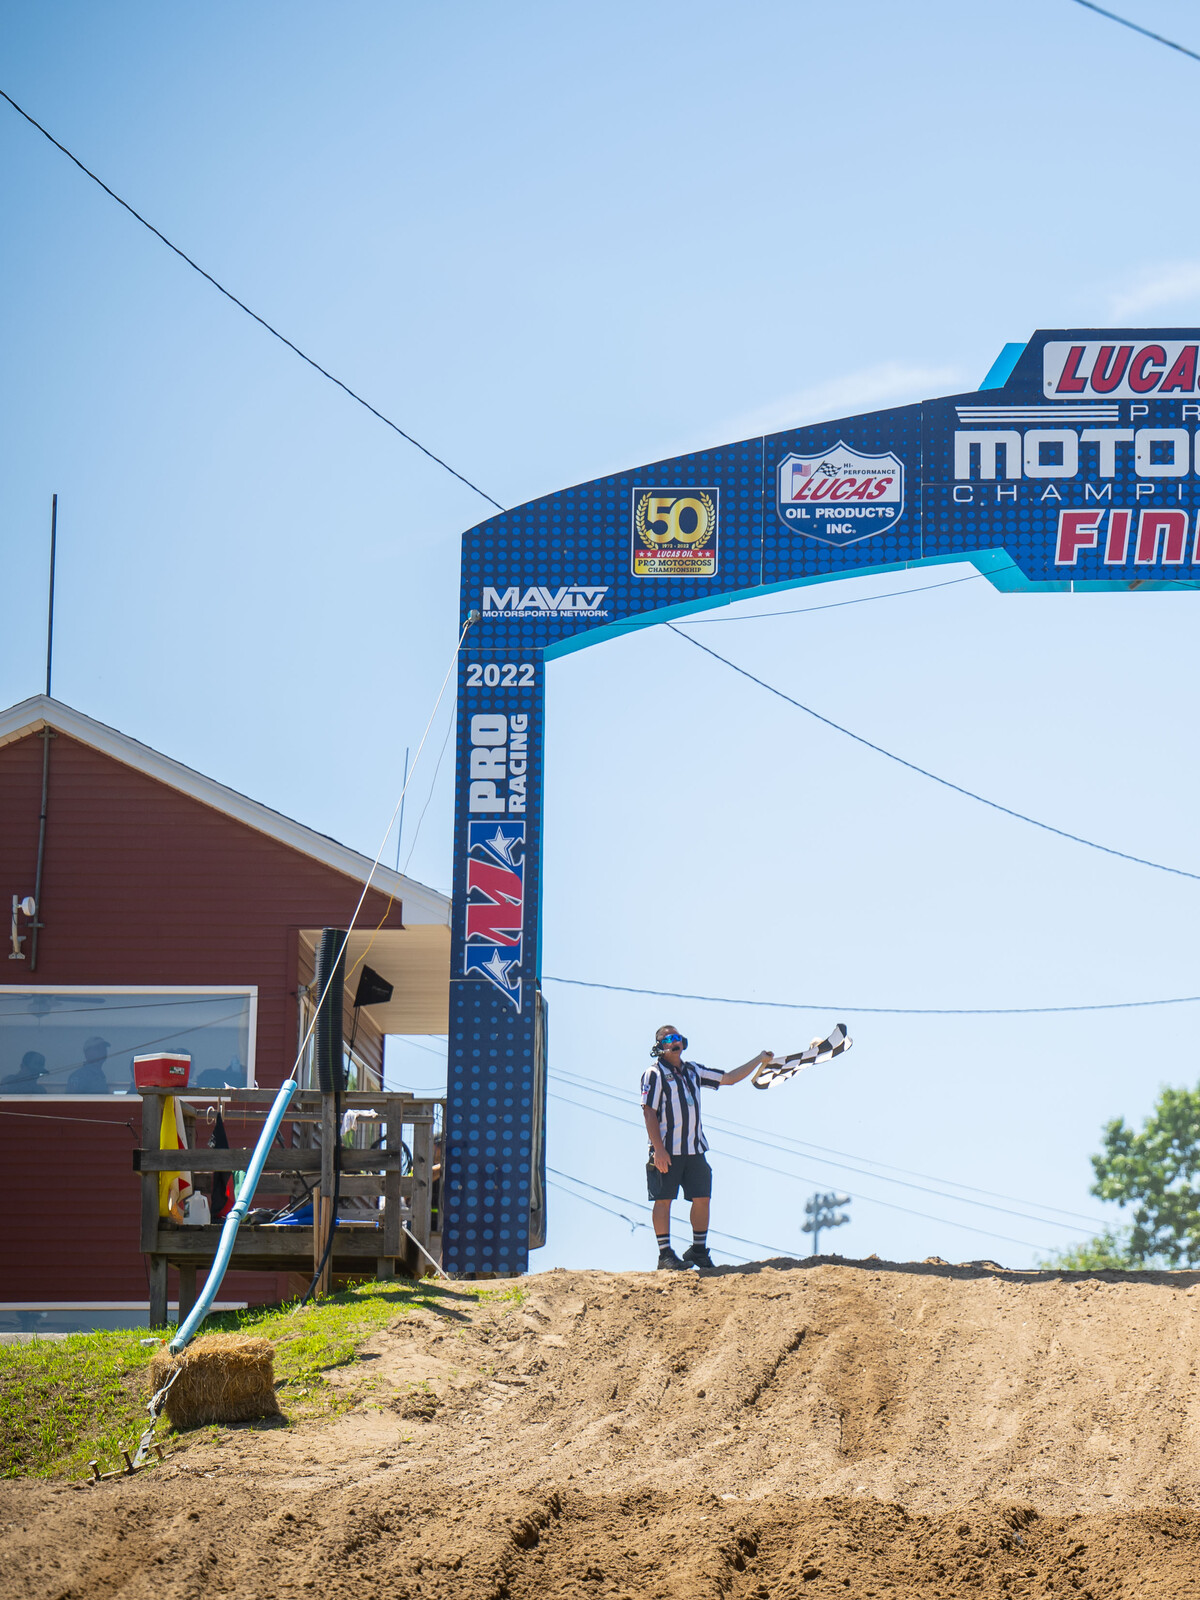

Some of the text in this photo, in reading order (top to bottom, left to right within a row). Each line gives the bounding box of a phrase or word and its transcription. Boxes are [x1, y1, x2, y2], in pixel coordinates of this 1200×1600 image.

[792, 477, 894, 500] LUCAS
[646, 498, 708, 544] 50
[785, 507, 894, 519] OIL PRODUCTS
[482, 586, 609, 610] MAVTV
[466, 664, 534, 687] 2022
[469, 714, 508, 812] PRO
[508, 714, 528, 812] RACING
